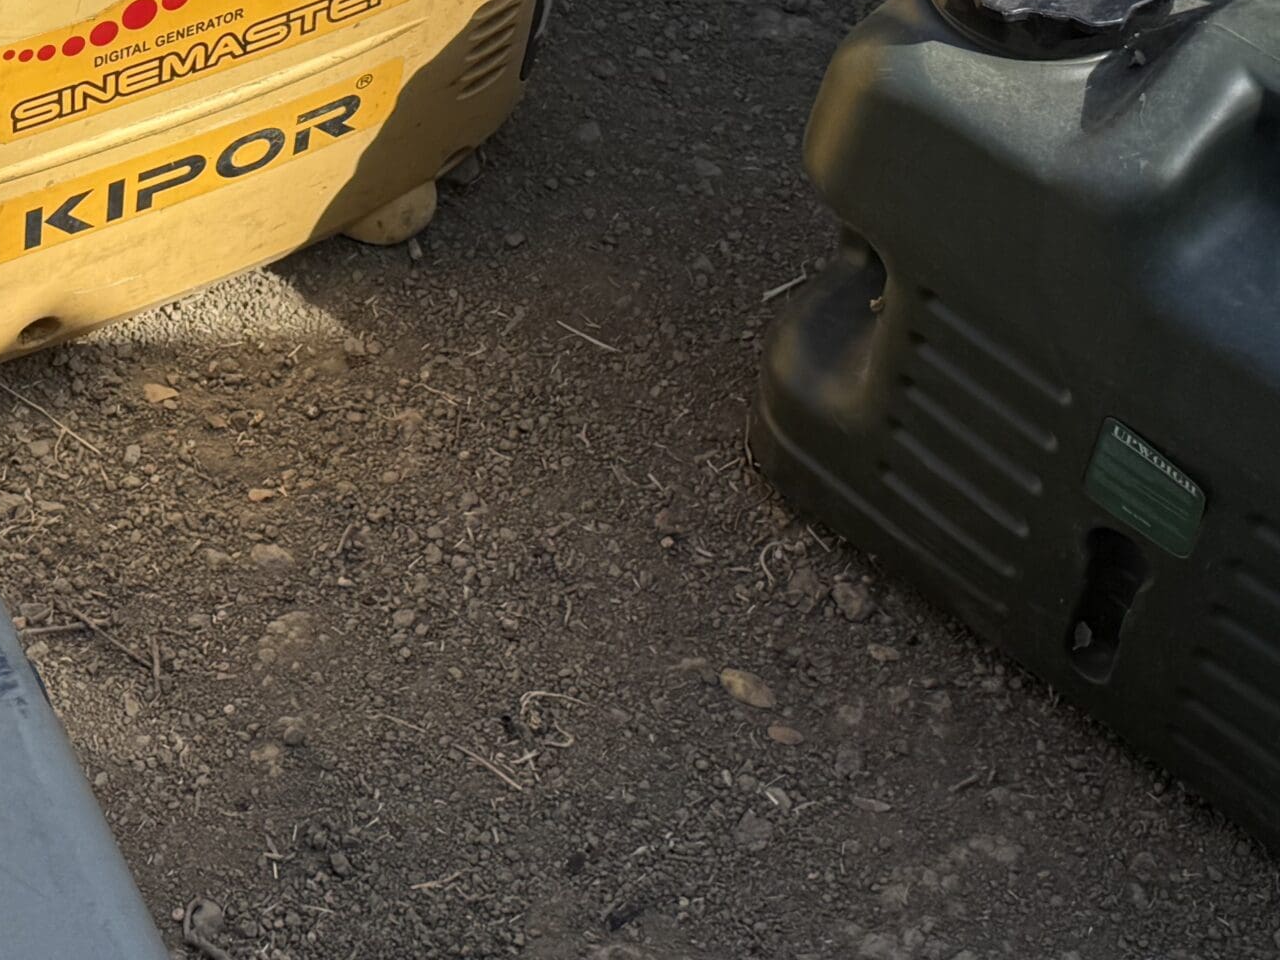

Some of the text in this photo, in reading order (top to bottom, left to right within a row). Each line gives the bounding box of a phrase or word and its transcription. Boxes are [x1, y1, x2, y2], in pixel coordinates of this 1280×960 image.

[94, 8, 244, 68] DIGITAL GENERATOR
[24, 93, 361, 250] KIPOR
